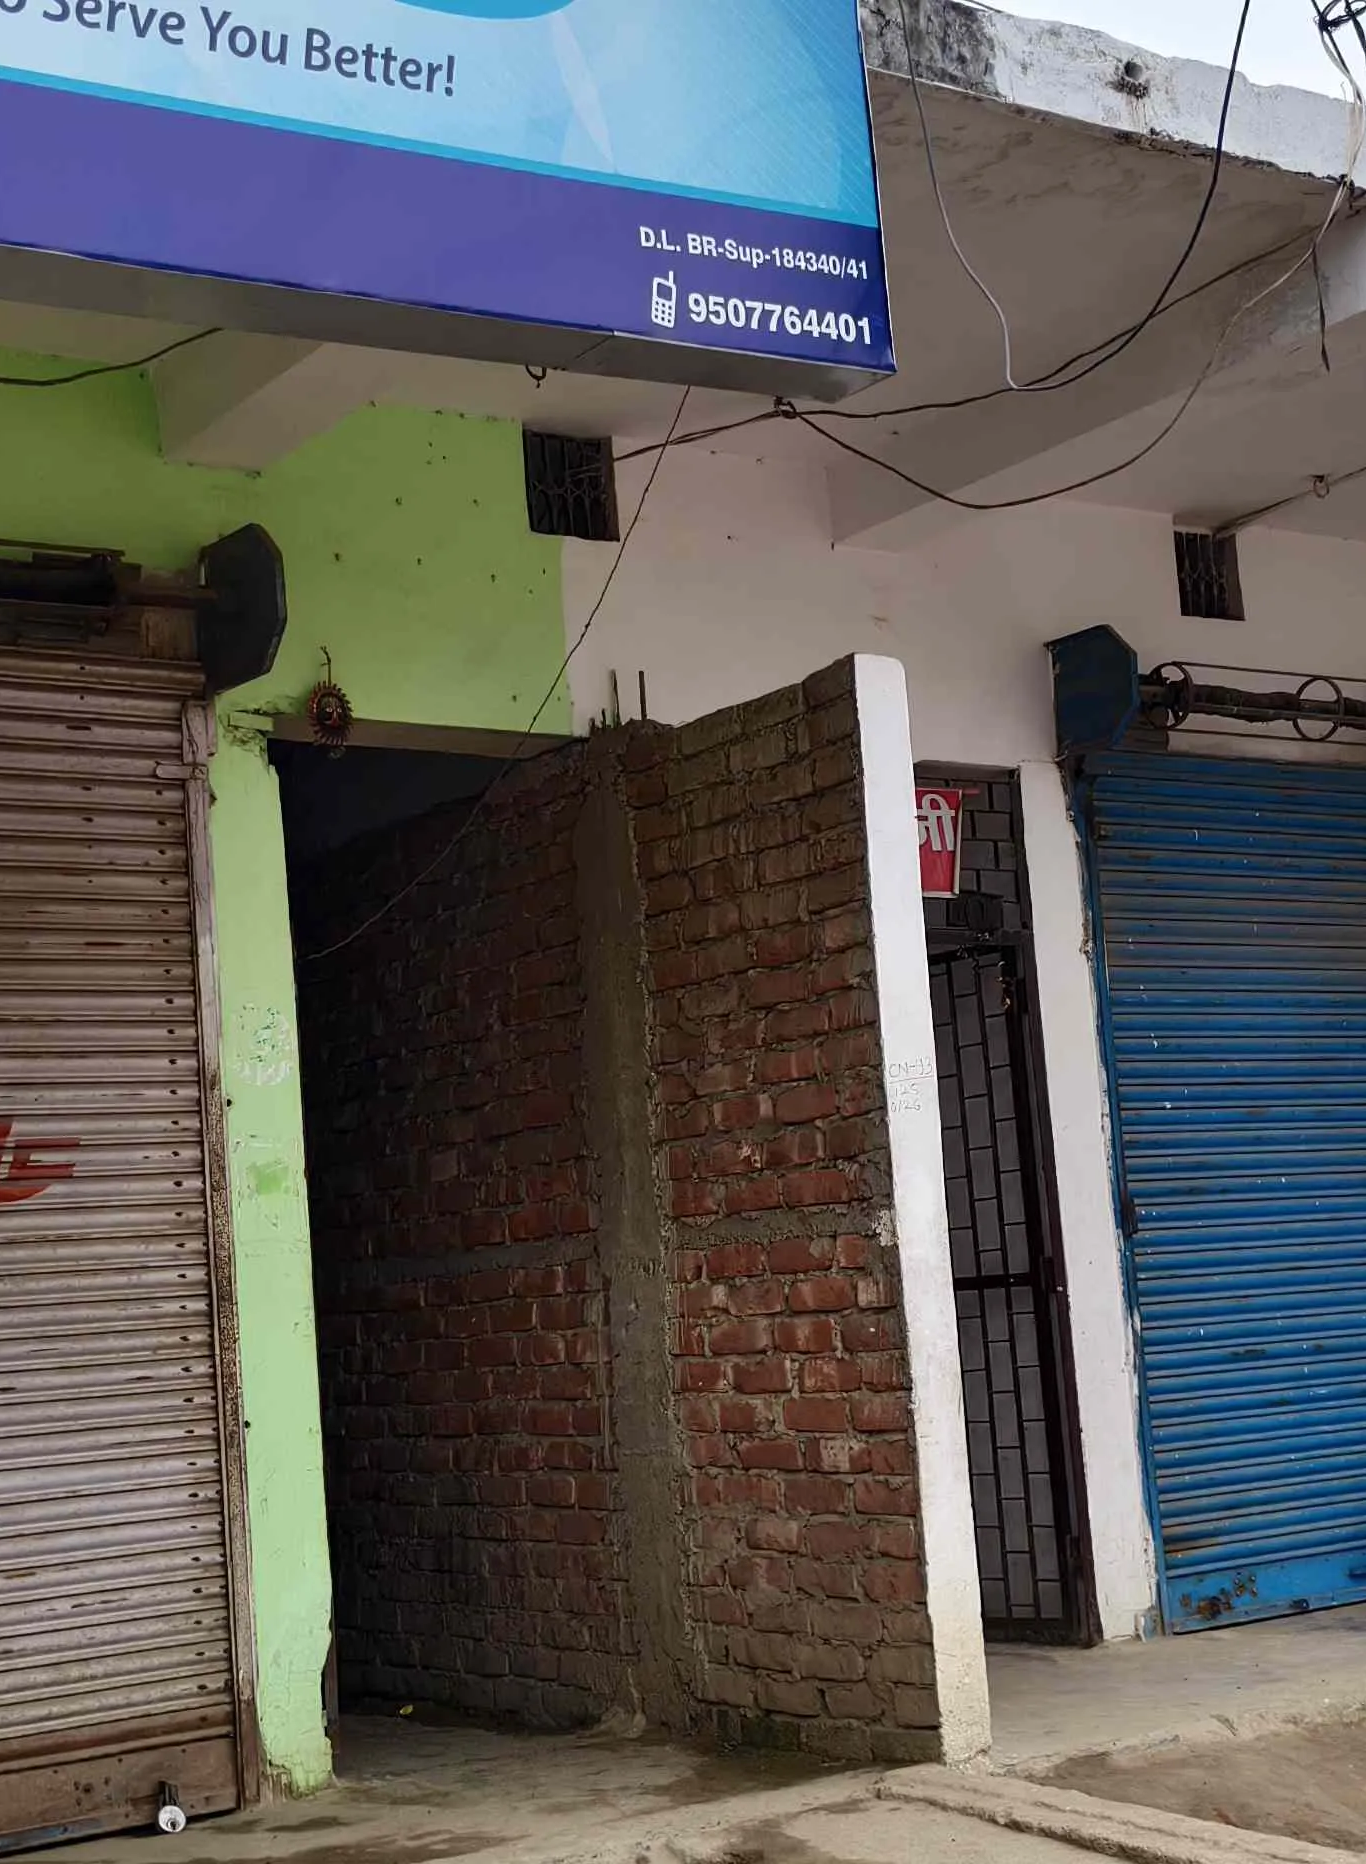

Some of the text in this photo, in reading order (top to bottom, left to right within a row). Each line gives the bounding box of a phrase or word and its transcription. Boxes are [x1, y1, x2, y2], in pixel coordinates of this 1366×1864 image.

[201, 7, 289, 65] You
[303, 28, 455, 96] Better!
[639, 226, 868, 279] D.L. BR-Sup-184340/41
[688, 292, 872, 345] 9507764401
